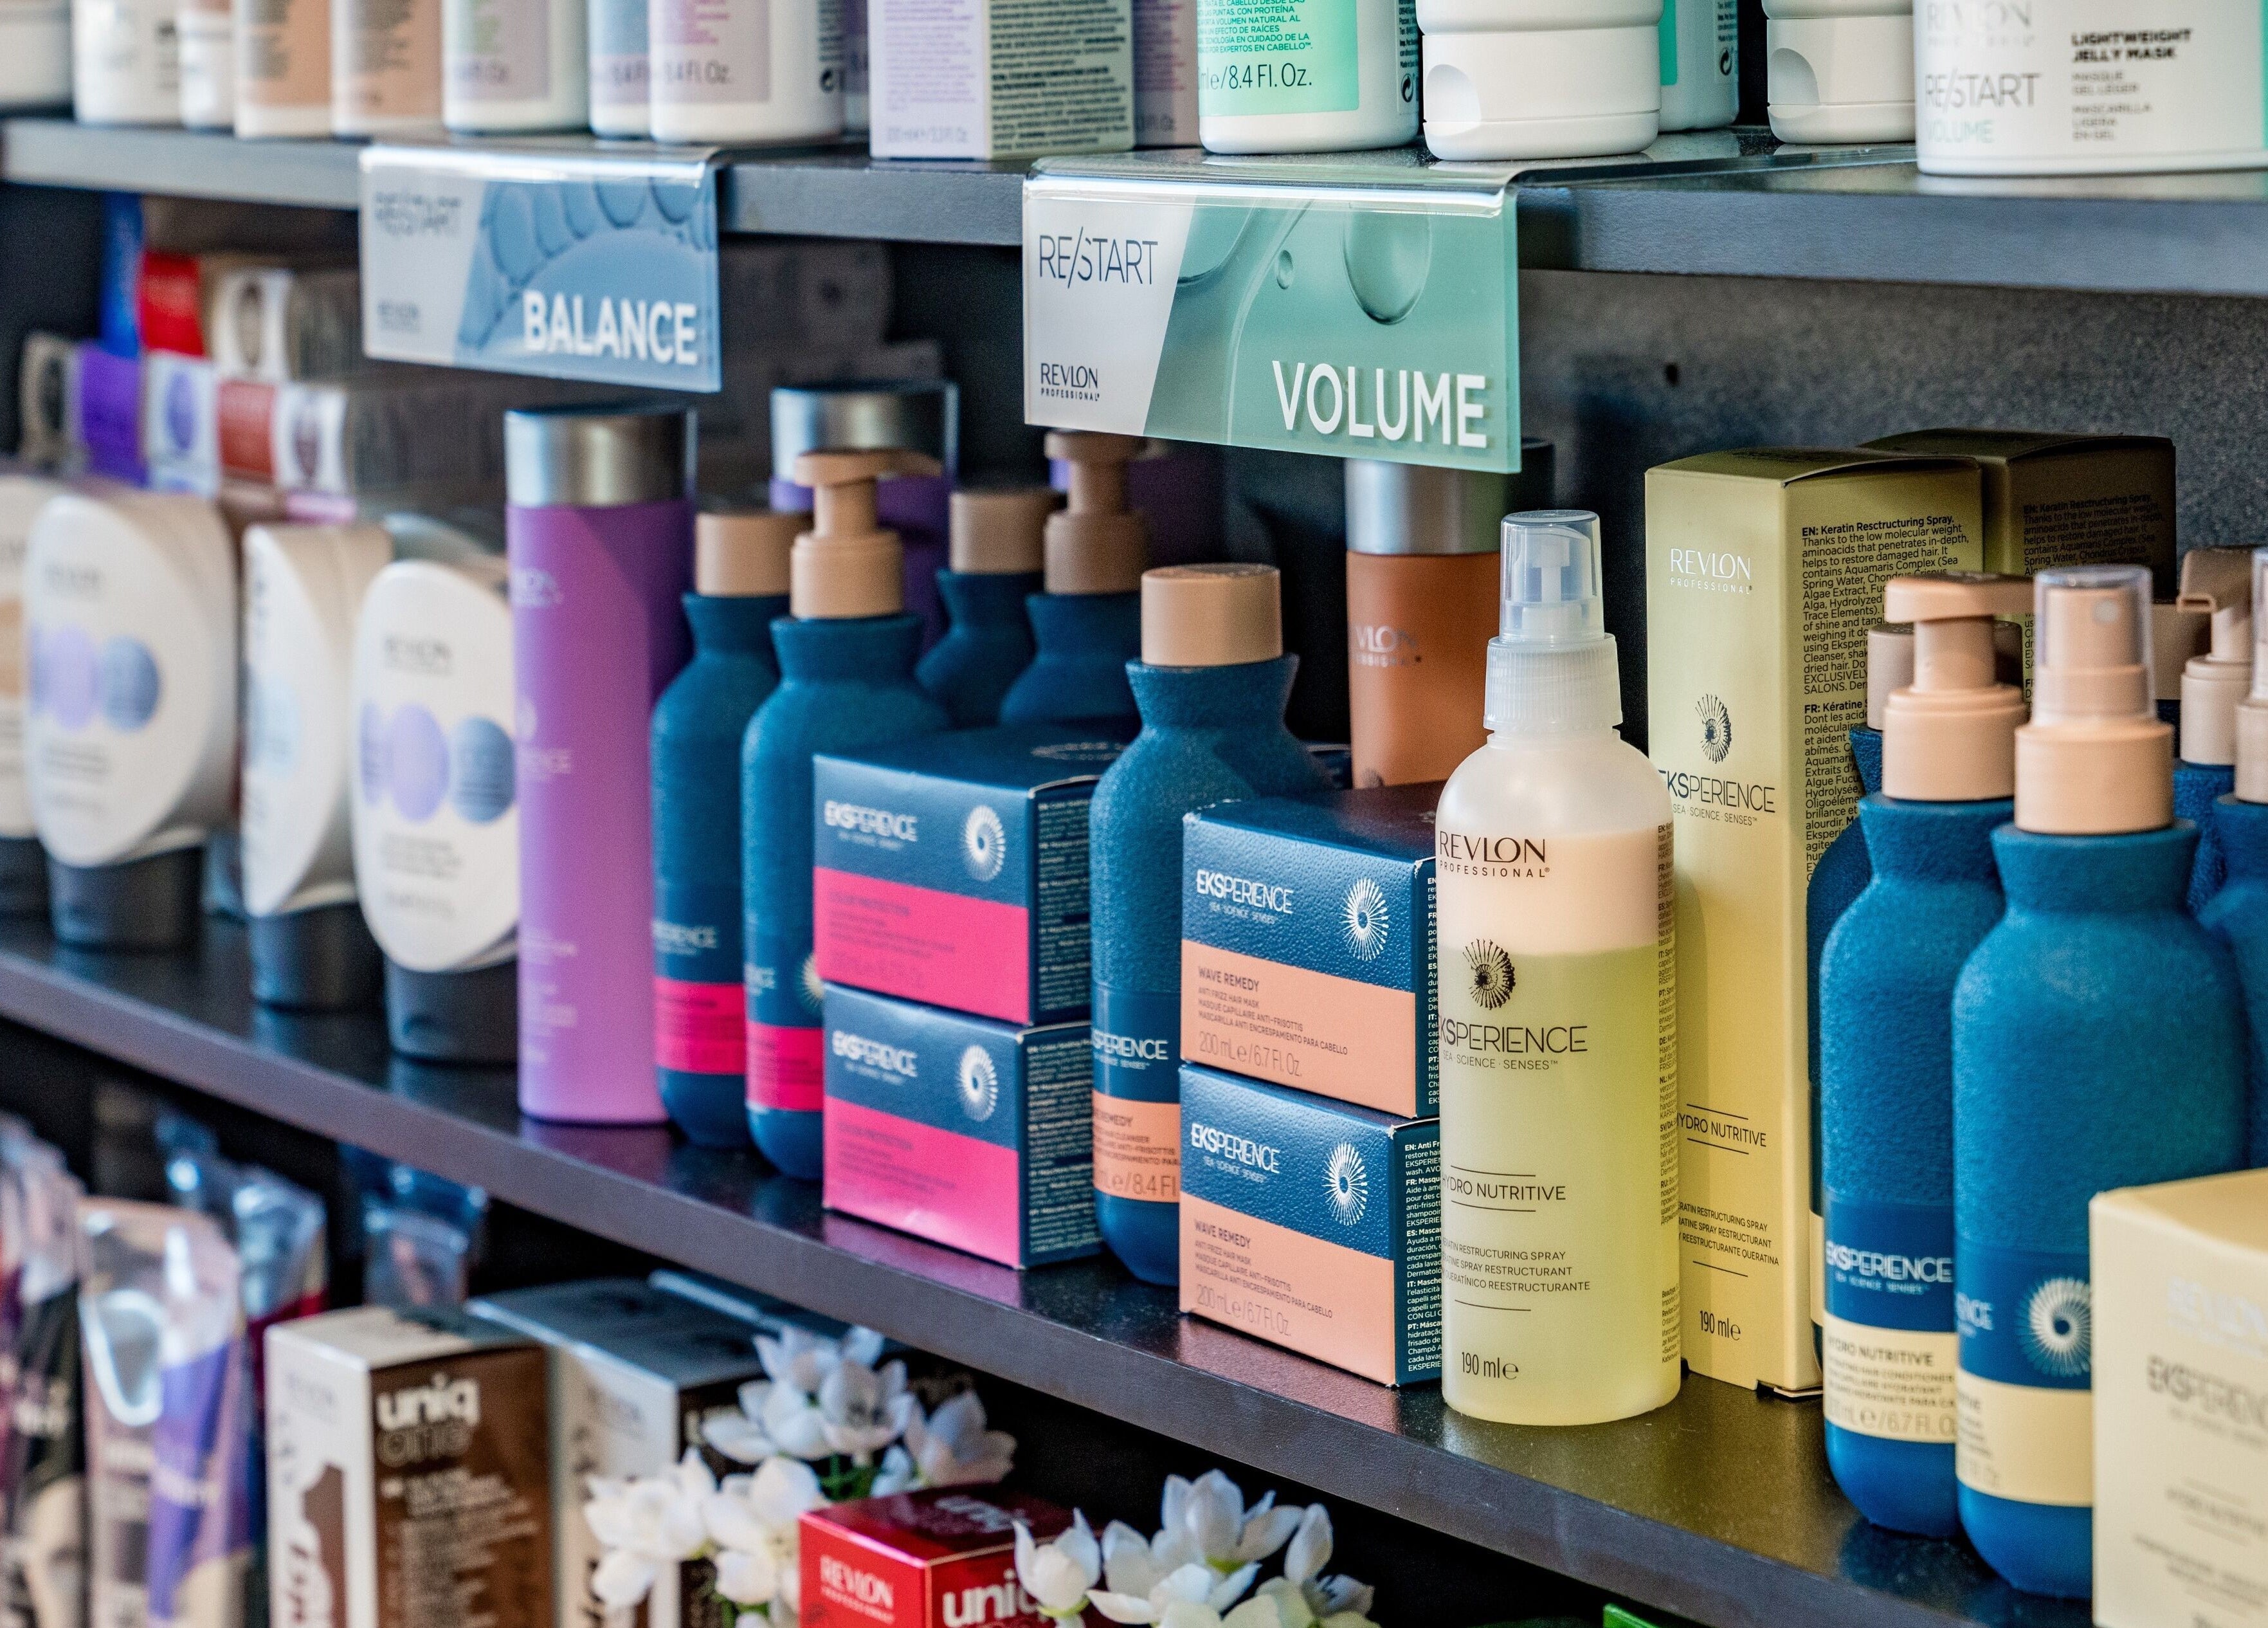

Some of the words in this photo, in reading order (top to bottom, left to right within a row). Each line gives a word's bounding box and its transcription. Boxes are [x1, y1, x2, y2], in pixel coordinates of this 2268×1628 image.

[1255, 5, 1294, 14] PROTEÍNA
[2071, 29, 2193, 47] LIGHTWEIGHT
[2072, 48, 2123, 63] JELLY
[2127, 47, 2176, 60] MASK
[1258, 64, 1276, 87] Fl.
[1282, 63, 1312, 87] Oz.
[1039, 226, 1158, 289] RE/START
[523, 290, 698, 365] BALANCE
[1040, 363, 1098, 389] REVLON
[1273, 360, 1487, 448] VOLUME
[1802, 527, 1819, 536] EN:
[1821, 524, 1855, 534] Keratin
[1857, 517, 1924, 531] Resctructuring
[1927, 515, 1954, 526] Spray.
[1802, 538, 1835, 547] Thanks
[1850, 534, 1864, 542] the
[1866, 533, 1882, 541] low
[1885, 528, 1929, 539] molecular
[1932, 524, 1962, 535] weight
[1802, 546, 1855, 557] aminoacids
[1858, 543, 1875, 552] that
[1878, 540, 1927, 553] penetrates
[1929, 535, 1969, 546] in-depth,
[1671, 548, 1750, 580] REVLON
[1802, 558, 1827, 568] helps
[1842, 554, 1874, 565] restore
[1876, 549, 1919, 562] damaged
[1921, 547, 1939, 556] hair.
[1802, 569, 1842, 579] contains
[1845, 563, 1893, 575] Aquamaris
[1896, 559, 1936, 571] Complex
[1938, 557, 1957, 566] (Sea
[1803, 579, 1833, 589] Spring
[1836, 576, 1865, 585] Water,
[1803, 590, 1830, 599] Algae
[1833, 588, 1868, 596] Extract,
[1803, 602, 1828, 611] Alga,
[1830, 594, 1882, 608] Hydrolyzed
[1803, 611, 1829, 621] Trace
[1831, 605, 1880, 617] Elements).
[1803, 623, 1813, 631] of
[1815, 620, 1840, 630] shine
[1842, 617, 1859, 627] and
[1803, 630, 1846, 642] weighing
[1849, 628, 1855, 637] it
[1803, 642, 1829, 653] using
[1804, 652, 1846, 663] Cleanser,
[1804, 663, 1829, 673] dried
[1831, 661, 1850, 670] hair.
[1852, 659, 1865, 669] Do
[1804, 682, 1847, 695] SALONS.
[1804, 704, 1821, 713] FR:
[1823, 701, 1862, 712] Kératine
[1805, 715, 1828, 725] Dont
[1817, 735, 1846, 745] aident
[1658, 769, 1775, 814] KSPERIENCE
[1673, 803, 1686, 814] SEA
[1689, 807, 1720, 821] SCIENCE
[1440, 830, 1545, 863] REVLON
[1196, 868, 1294, 914] EKSPERIENCE
[1199, 967, 1222, 983] WAVE
[1224, 973, 1259, 992] REMEDY
[1229, 994, 1242, 1005] HAIR
[1244, 998, 1259, 1008] MASK
[1199, 998, 1222, 1011] MASQUE
[1222, 1005, 1255, 1020] CAPILLAIRE
[1256, 1013, 1303, 1032] ANTI-FRISOTTIS
[1199, 1011, 1234, 1026] MASCARILLA
[1235, 1020, 1248, 1030] ANTI
[1249, 1024, 1302, 1043] ENCRESPAMIENTO
[1303, 1037, 1319, 1048] PARA
[1320, 1041, 1347, 1056] CABELLO
[1438, 1014, 1588, 1053] KSPERIENCE
[1443, 1049, 1453, 1061] SEA
[1456, 1054, 1495, 1068] SCIENCE
[1711, 1122, 1766, 1148] NUTRITIVE
[1191, 1122, 1280, 1174] EKSPERIENCE
[1476, 1183, 1566, 1201] NUTRITIVE
[1697, 1206, 1745, 1227] RESTRUCTURING
[1747, 1220, 1767, 1232] SPRAY
[1195, 1220, 1217, 1238] WAVE
[1218, 1227, 1251, 1248] REMEDY
[1699, 1221, 1717, 1234] SPRAY
[1718, 1228, 1772, 1248] RESTRUCTURANT
[1407, 1244, 1437, 1253] duración,
[1459, 1243, 1529, 1261] RESTRUCTURING
[1530, 1252, 1566, 1260] SPRAY
[1682, 1234, 1741, 1256] REESTRUCTURANTE
[1742, 1248, 1779, 1266] QUERATINA
[1461, 1261, 1483, 1273] SPRAY
[1485, 1265, 1572, 1276] RESTRUCTURANT
[1488, 1281, 1590, 1292] REESTRUCTURANTE
[1292, 1297, 1305, 1308] PARA
[1307, 1303, 1332, 1318] CABELLO
[1408, 1296, 1428, 1304] capelli
[1408, 1304, 1428, 1313] capelli
[1700, 1311, 1714, 1333] 190
[1408, 1346, 1436, 1355] Champô
[1858, 1344, 1933, 1367] NUTRITIVE
[1462, 1352, 1479, 1375] 190
[820, 1555, 894, 1609] REVLON
